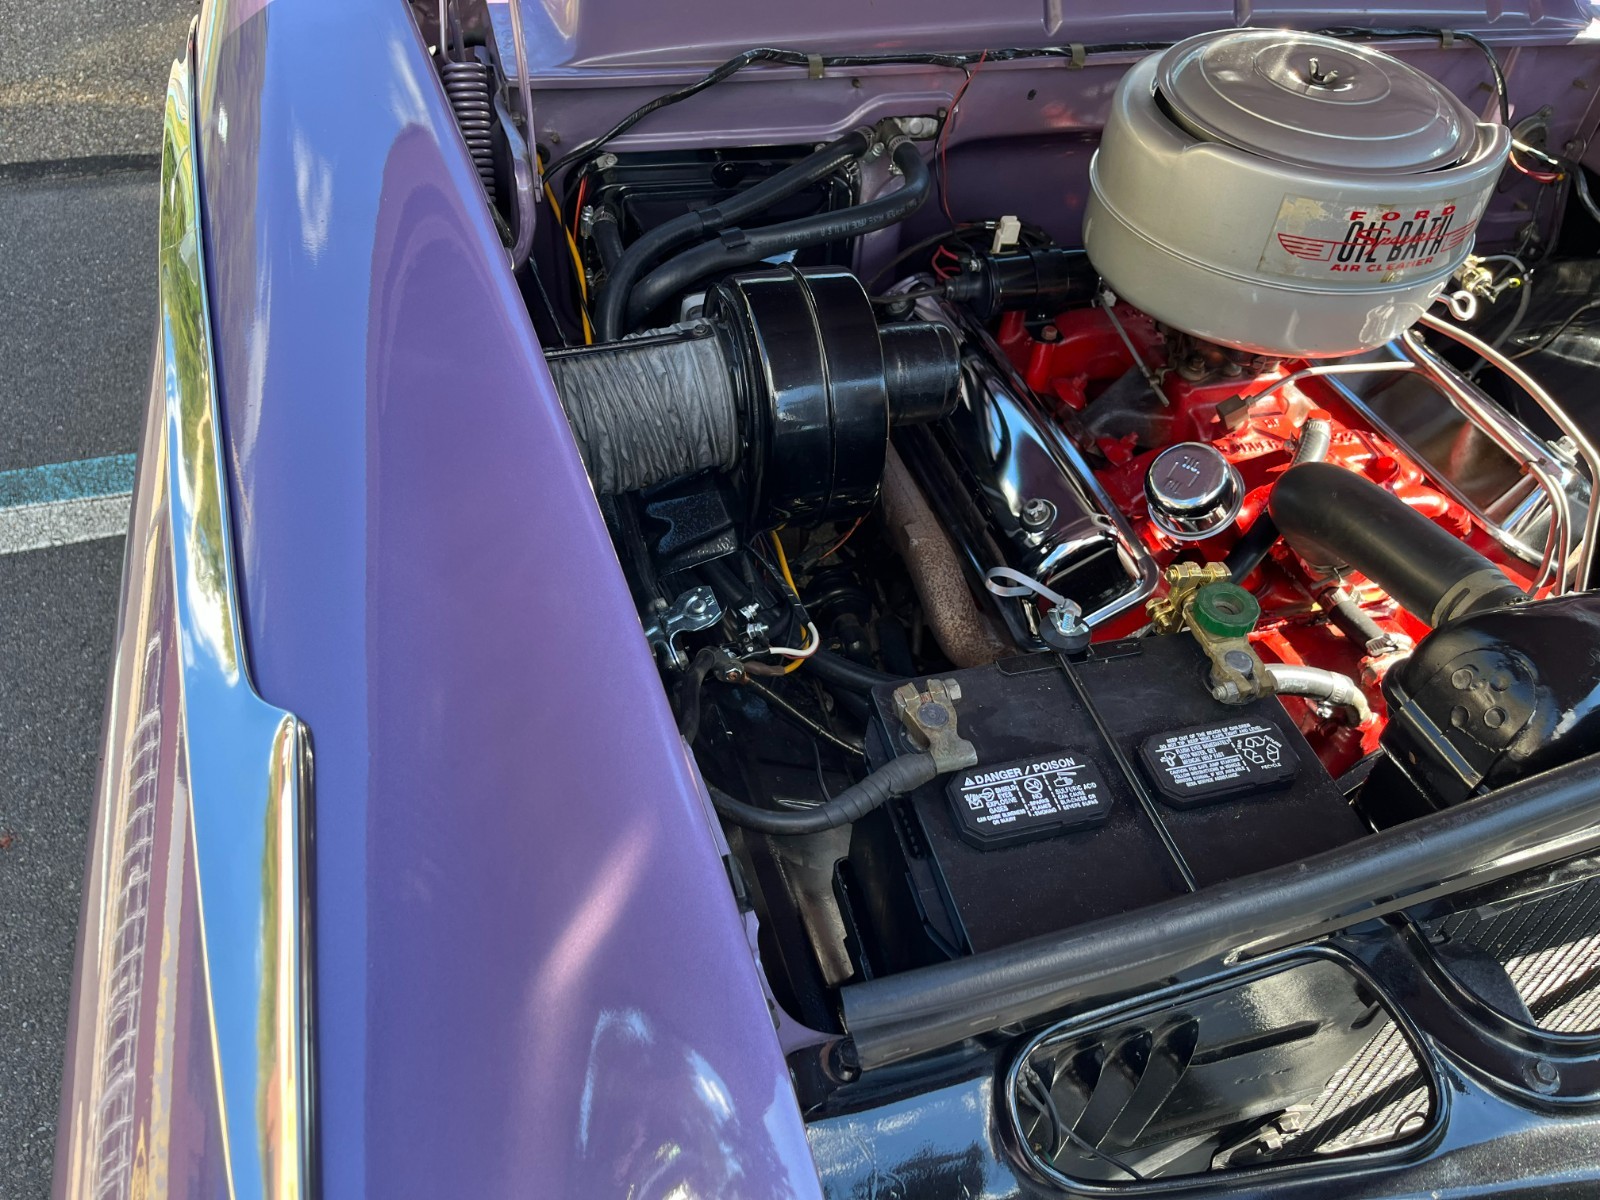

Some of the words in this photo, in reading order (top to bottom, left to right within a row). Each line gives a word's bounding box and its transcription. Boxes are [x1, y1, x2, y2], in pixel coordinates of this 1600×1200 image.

[1350, 205, 1456, 221] FORD
[1337, 221, 1387, 263] OIL
[1386, 213, 1454, 262] BATH
[1330, 264, 1360, 272] AIR
[1366, 256, 1434, 272] CLEANER
[974, 767, 1023, 785] DANGER
[1032, 757, 1076, 773] POISON
[995, 784, 1016, 793] SHIELD
[1055, 785, 1083, 795] SULFURIC
[1083, 781, 1097, 790] ACID
[986, 796, 1018, 808] EXPLOSIVE
[997, 791, 1013, 800] EYES
[1032, 792, 1043, 800] NO
[989, 805, 1009, 814] GASES
